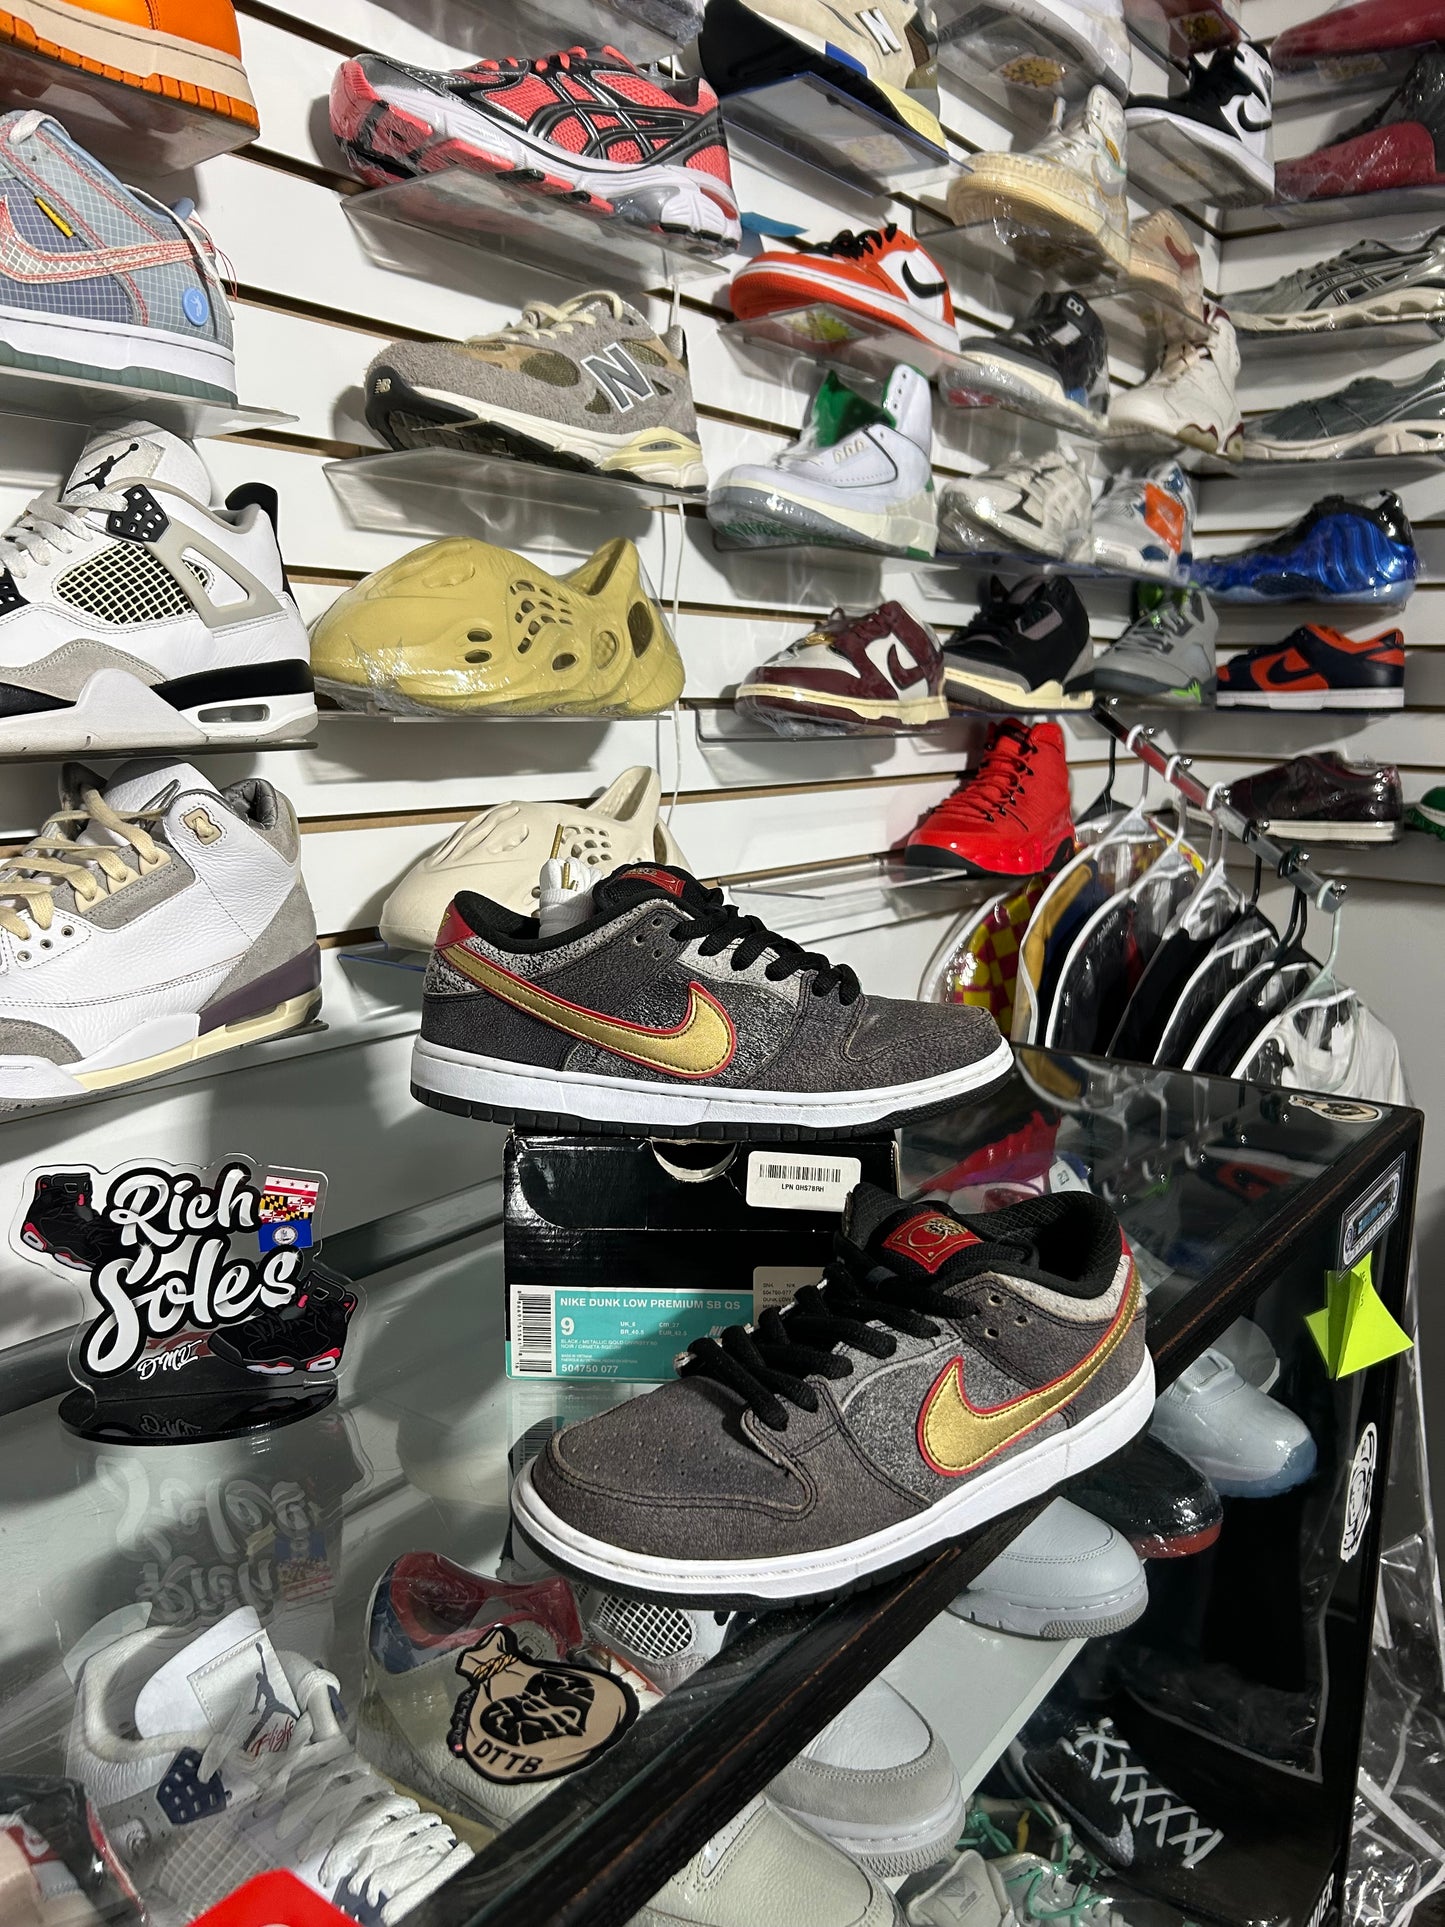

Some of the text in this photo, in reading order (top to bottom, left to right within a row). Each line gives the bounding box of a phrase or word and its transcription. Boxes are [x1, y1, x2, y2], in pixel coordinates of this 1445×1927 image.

[857, 8, 902, 54] N
[580, 342, 655, 413] N
[781, 1183, 794, 1191] LPN
[109, 1167, 255, 1247] Rich
[86, 1238, 299, 1373] Soles
[560, 1298, 741, 1310] NIKE DUNK LOW PREMIUM SB QS
[560, 1317, 575, 1336] 9
[137, 1339, 202, 1380] DMV
[561, 1364, 619, 1373] 504750 077
[472, 1737, 544, 1774] DTTB
